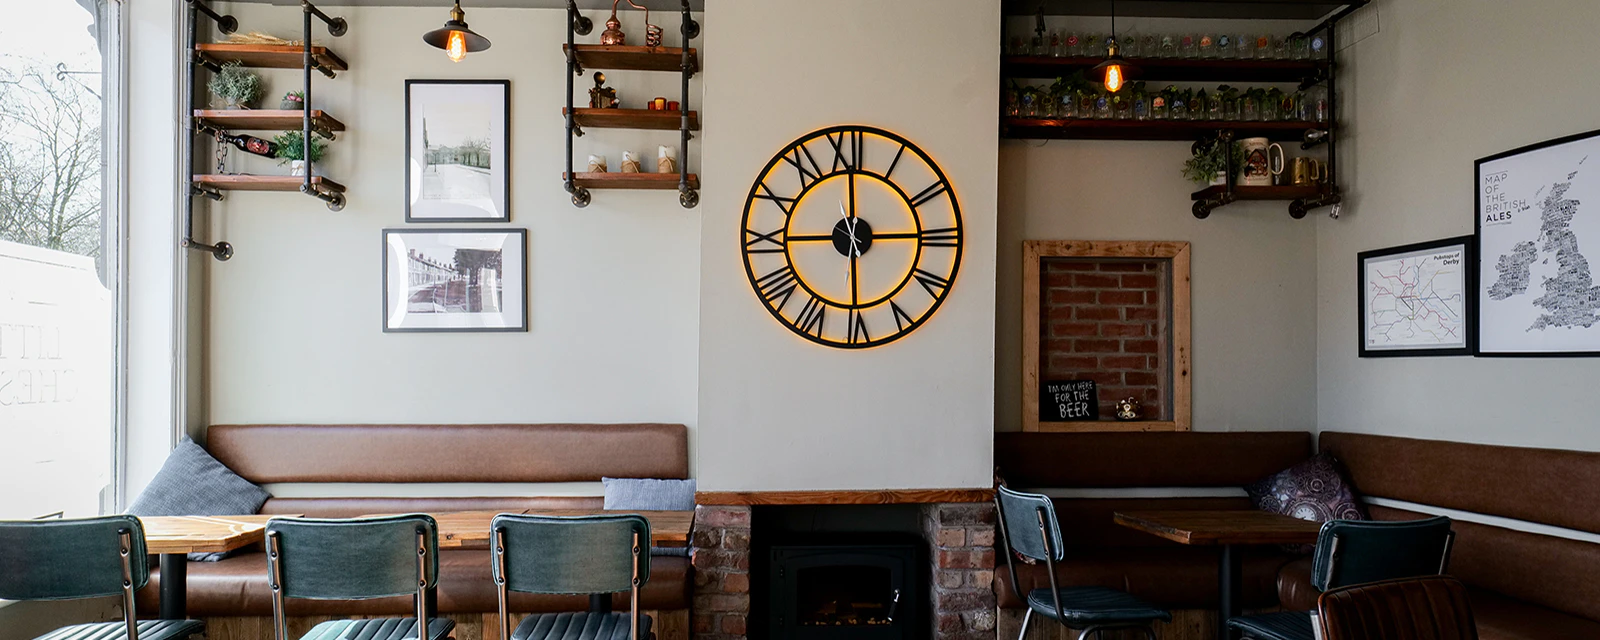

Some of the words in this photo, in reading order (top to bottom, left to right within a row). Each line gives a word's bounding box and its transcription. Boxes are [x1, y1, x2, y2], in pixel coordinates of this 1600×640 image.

[1485, 173, 1508, 185] MAP
[1485, 184, 1499, 194] OF
[1485, 193, 1505, 204] THE
[1485, 199, 1526, 213] BRITISH
[1486, 211, 1512, 222] ALES
[1077, 381, 1093, 390] HERE
[1055, 393, 1071, 403] FOR
[1074, 390, 1089, 401] THE
[1059, 401, 1090, 418] BEER
